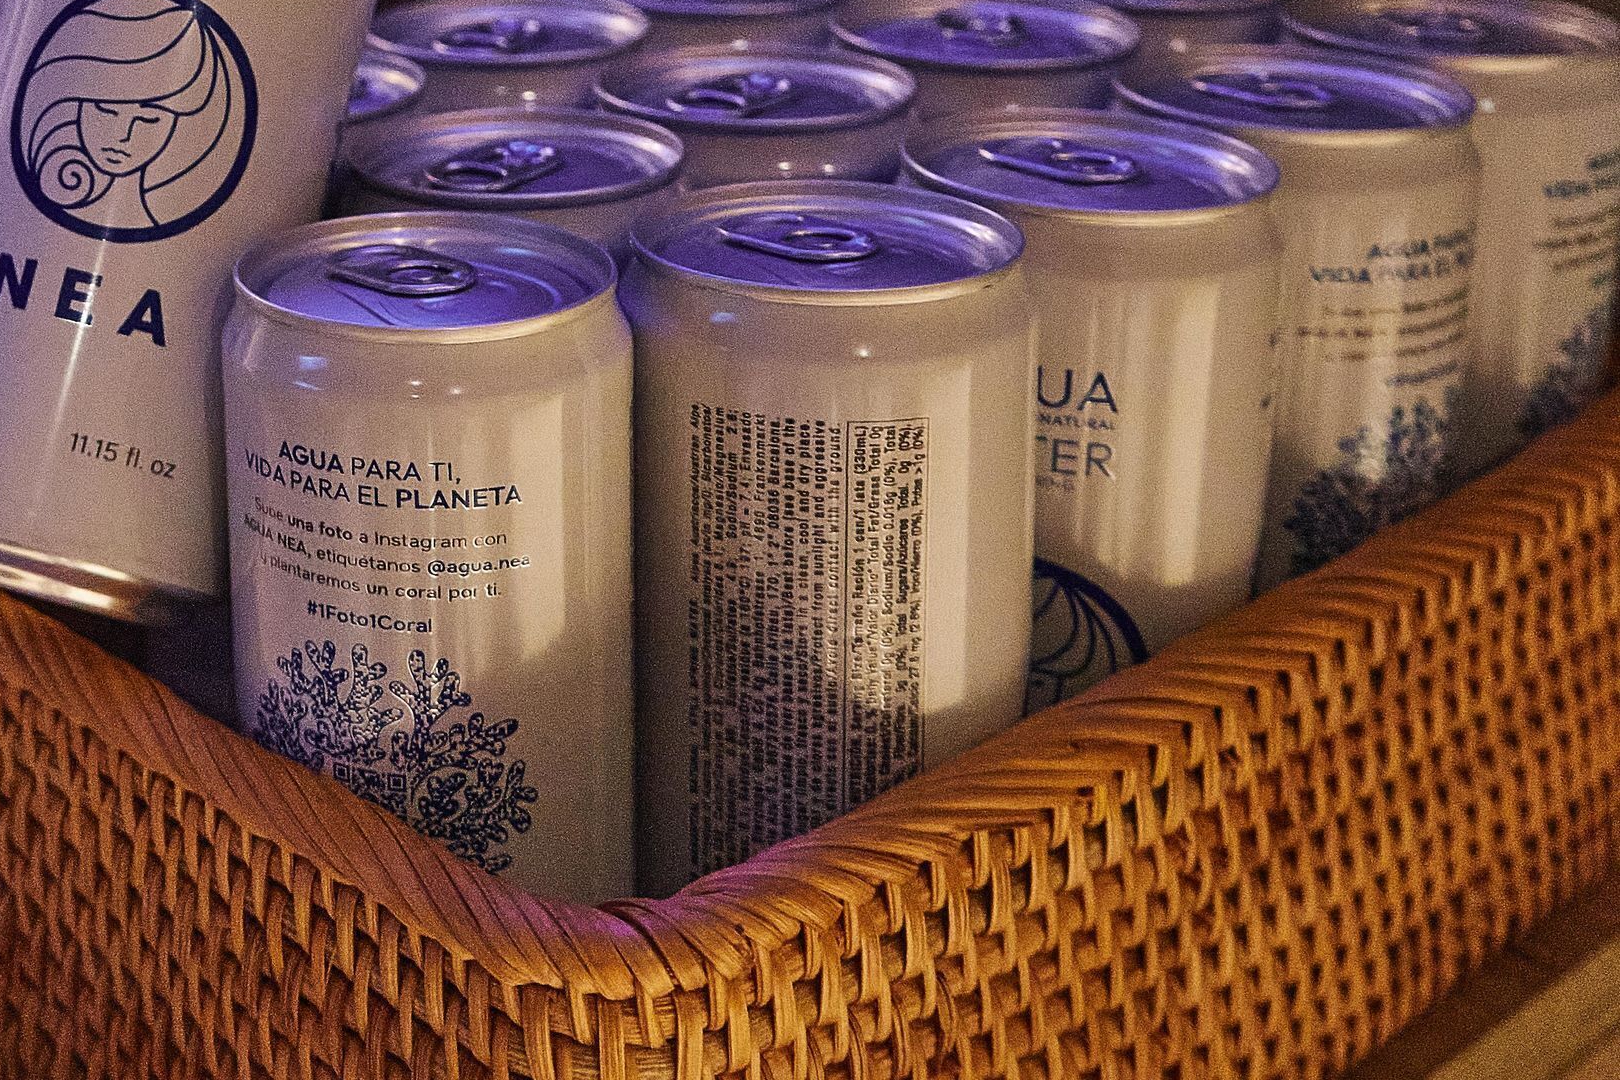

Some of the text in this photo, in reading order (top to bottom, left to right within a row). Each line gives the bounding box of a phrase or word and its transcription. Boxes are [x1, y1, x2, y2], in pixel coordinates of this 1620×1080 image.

[1037, 365, 1118, 413] UA
[740, 412, 751, 471] Envasado
[782, 417, 795, 439] the
[797, 420, 810, 459] place.
[829, 422, 841, 473] ground.
[883, 425, 897, 454] Total
[70, 432, 177, 478] 11.15 fl. oz
[278, 440, 461, 484] AGUA PARA TI,
[754, 414, 765, 502] Frankenmarkt
[782, 442, 795, 456] of
[813, 420, 826, 490] aggressive
[853, 425, 868, 475] (330mL)
[868, 444, 883, 472] Total
[1036, 435, 1113, 477] ER
[244, 448, 522, 510] VIDA PARA EL PLANETA
[782, 460, 795, 491] base
[797, 464, 810, 485] dry
[828, 480, 841, 500] the
[853, 480, 867, 503] lata
[797, 491, 810, 513] and
[812, 496, 826, 519] and
[828, 507, 840, 534] with
[868, 476, 882, 533] Fat/Grasa
[882, 492, 896, 531] 0.018g
[243, 513, 531, 578] AGUA NEA, etiquétanos @agua.nea
[287, 514, 314, 533] una
[319, 521, 353, 541] foto
[358, 532, 369, 544] a
[374, 531, 468, 552] Instagram
[474, 532, 507, 548] con
[797, 520, 810, 546] cool
[853, 509, 867, 543] can/1
[782, 526, 795, 567] before
[812, 524, 825, 576] sunlight
[828, 541, 840, 589] contact
[867, 537, 881, 565] Total
[270, 555, 361, 593] plantaremos
[366, 583, 389, 597] un
[395, 585, 441, 600] coral
[448, 587, 478, 603] por
[485, 582, 502, 598] ti.
[852, 558, 866, 600] Ración
[881, 534, 895, 616] Sodium/Sodio
[306, 598, 433, 633] #1Foto1Coral
[812, 583, 825, 611] from
